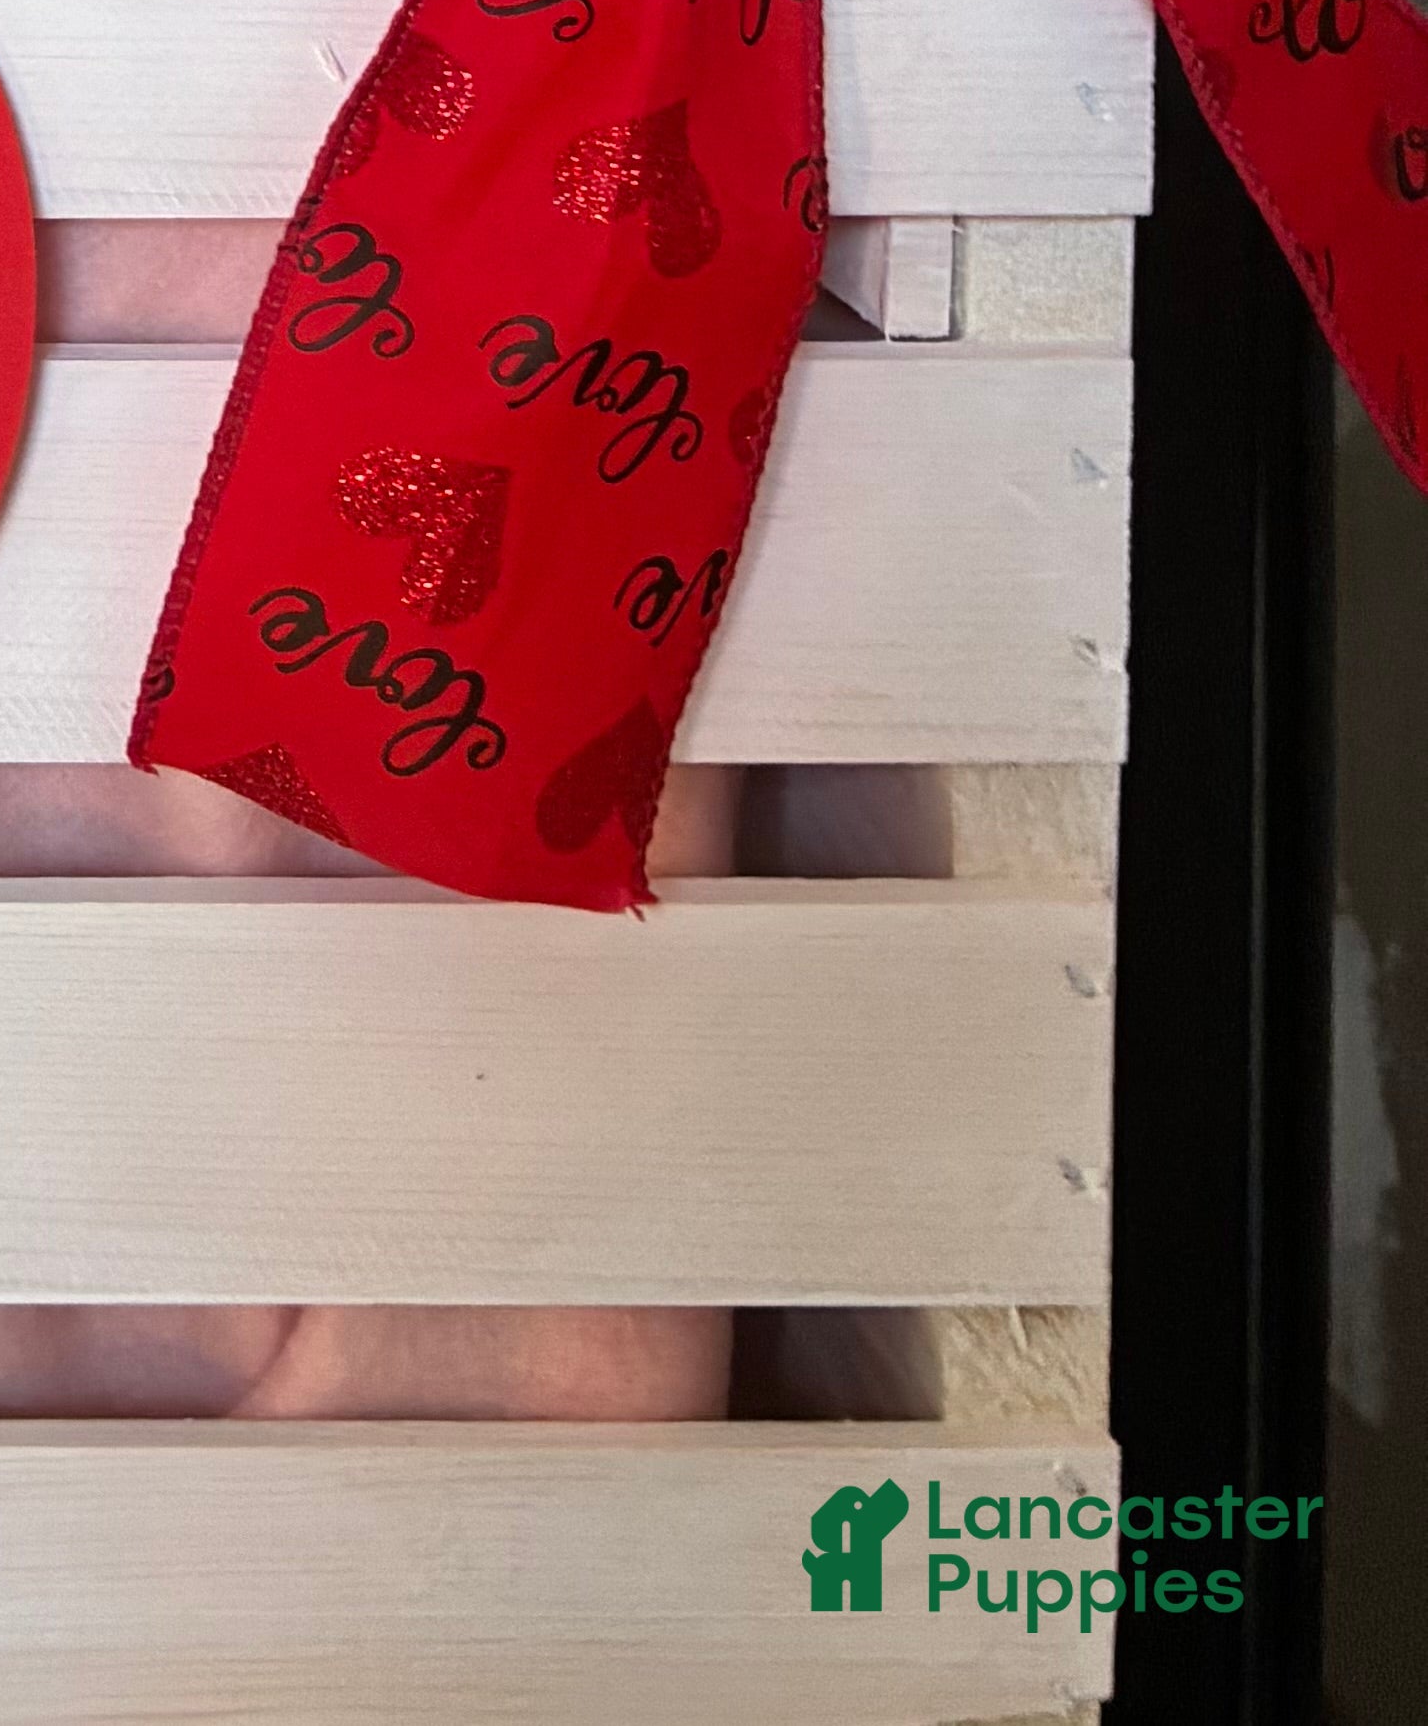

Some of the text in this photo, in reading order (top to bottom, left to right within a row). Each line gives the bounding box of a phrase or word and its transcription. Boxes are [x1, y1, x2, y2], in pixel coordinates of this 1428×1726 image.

[288, 222, 416, 361] lo
[479, 314, 704, 485] love
[248, 586, 508, 778] love
